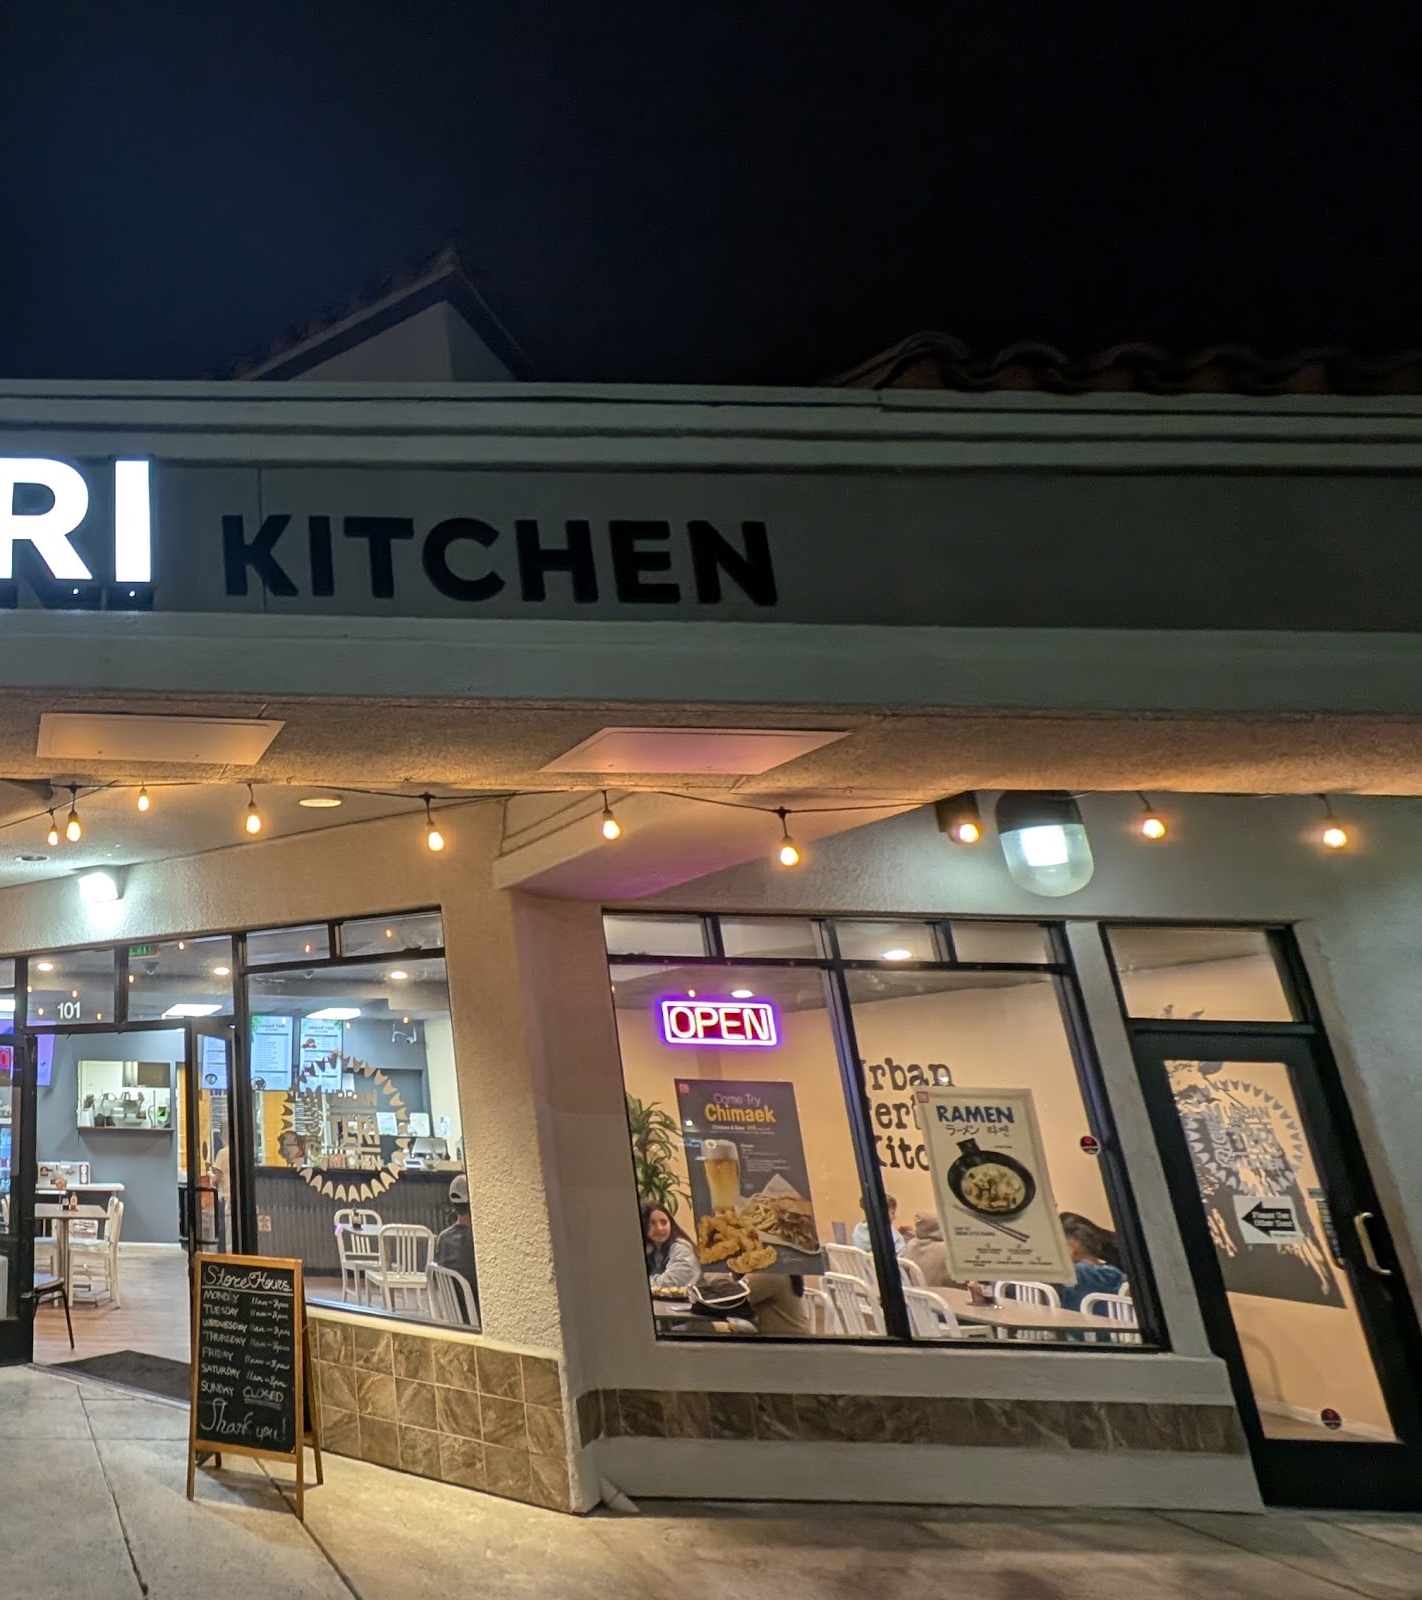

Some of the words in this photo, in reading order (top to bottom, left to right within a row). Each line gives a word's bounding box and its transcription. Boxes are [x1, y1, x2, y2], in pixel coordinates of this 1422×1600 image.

[220, 513, 779, 606] KITCHEN
[57, 1001, 81, 1019] 101
[669, 1006, 770, 1041] OPEN
[861, 1057, 955, 1090] rban
[713, 1093, 743, 1105] Come
[744, 1093, 761, 1107] Try
[705, 1103, 776, 1123] Chimaek
[936, 1105, 1015, 1124] RAMEN
[945, 1124, 980, 1136] ラーメン
[203, 1265, 250, 1288] Store
[249, 1271, 293, 1292] Hours
[203, 1290, 240, 1304] MONDY
[203, 1303, 239, 1317] TUESDAY
[202, 1330, 246, 1347] THURSDAY
[202, 1346, 234, 1361] FRIDAY
[201, 1363, 241, 1379] SATURDAY
[200, 1380, 234, 1397] SUNDAY
[243, 1386, 284, 1402] CLOSED
[200, 1397, 254, 1435] Thank
